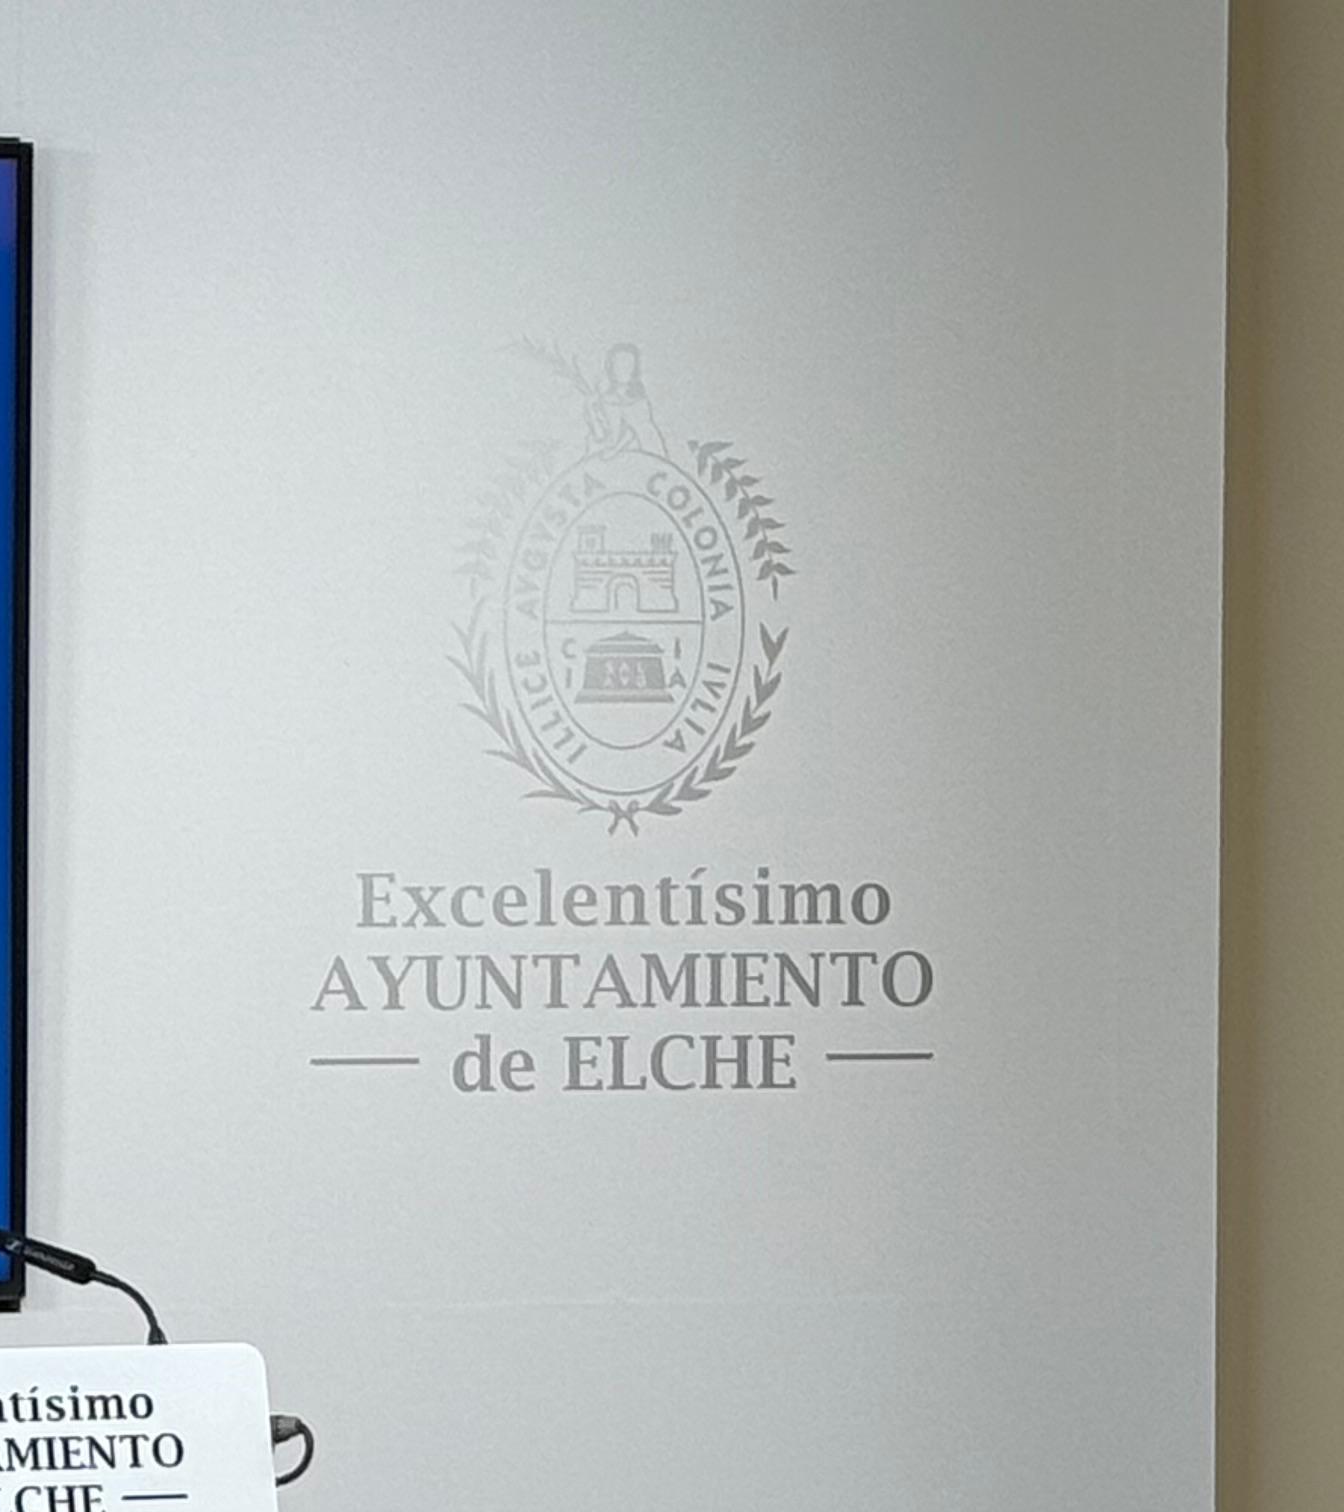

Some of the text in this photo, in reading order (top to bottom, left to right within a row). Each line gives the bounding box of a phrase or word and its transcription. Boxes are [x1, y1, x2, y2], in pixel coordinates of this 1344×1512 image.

[647, 472, 734, 621] COLONIA
[356, 867, 891, 929] Excelentísimo
[310, 950, 934, 1011] AYUNTAMIENTO
[452, 1034, 797, 1092] de ELCHE
